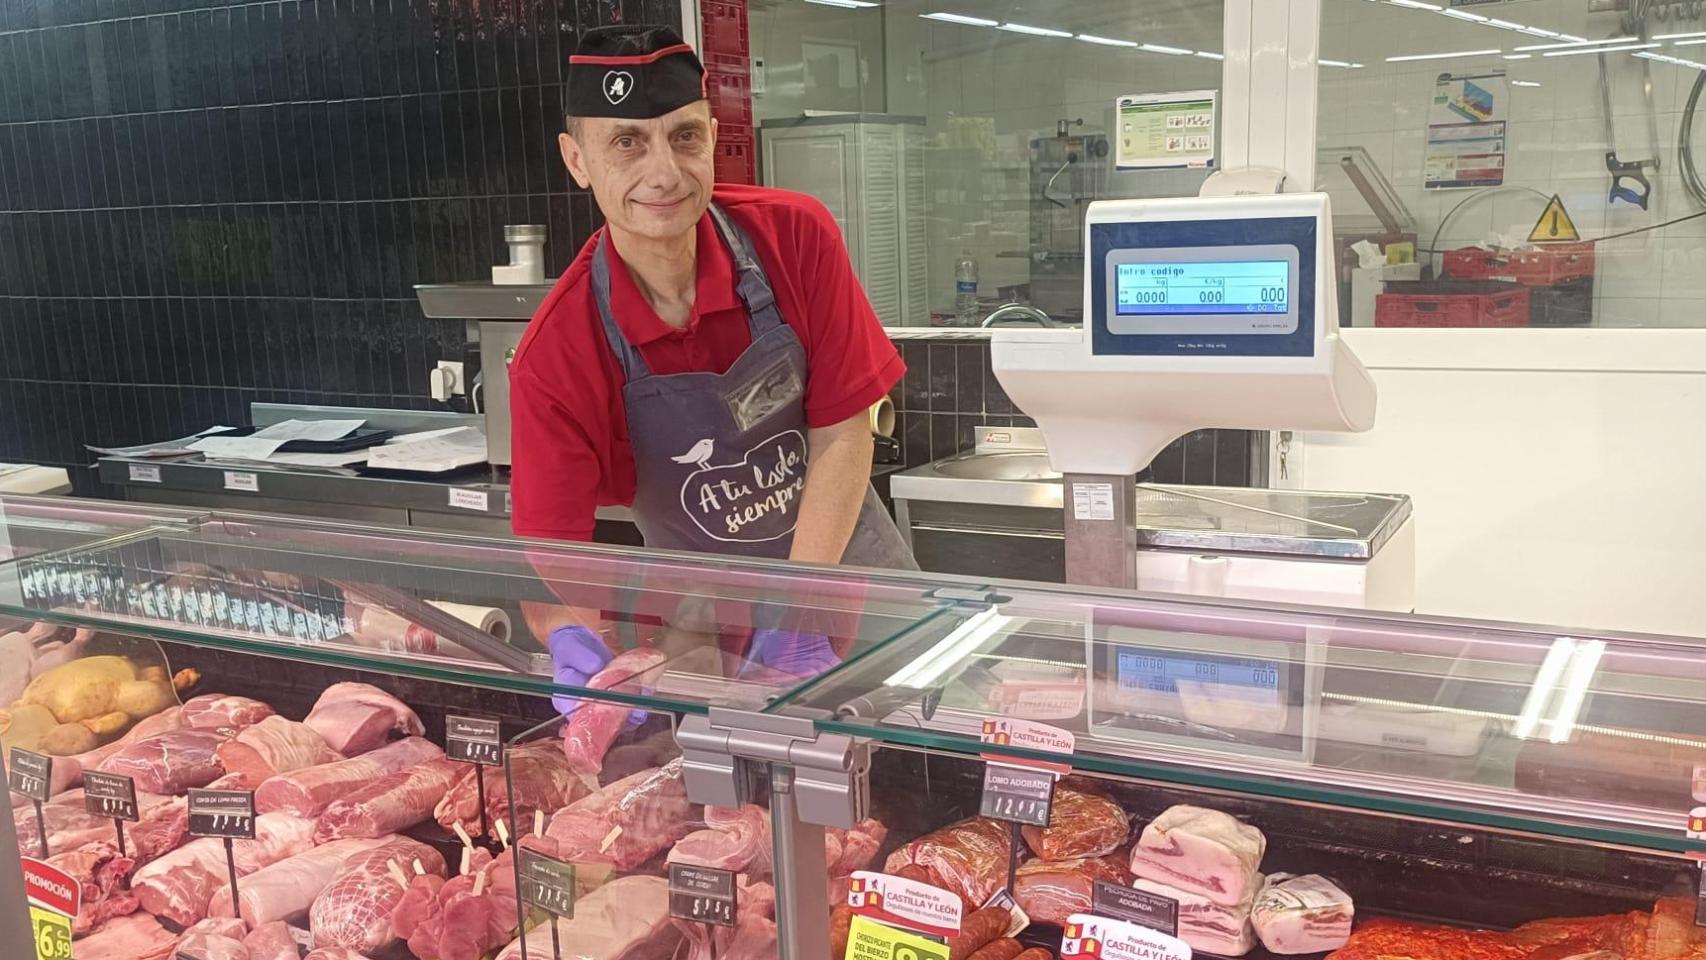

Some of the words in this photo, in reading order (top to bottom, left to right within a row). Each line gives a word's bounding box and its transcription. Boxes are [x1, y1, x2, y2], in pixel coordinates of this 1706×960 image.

[1119, 267, 1146, 275] Intro
[699, 483, 721, 513] A
[711, 479, 753, 501] tu
[725, 476, 804, 533] siempre
[1013, 731, 1044, 744] CASTILLA
[1053, 738, 1072, 750] LEÓN
[988, 775, 1008, 785] LOMO
[1010, 778, 1050, 790] ADOBADO
[25, 871, 73, 901] PROMOCIÓN
[905, 887, 932, 901] Producto
[932, 895, 941, 903] de
[887, 891, 926, 910] CASTILLA
[927, 902, 935, 911] Y
[935, 903, 958, 917] LEÓN
[854, 942, 866, 953] DEL
[867, 946, 889, 959] BIERZO
[1106, 939, 1149, 958] CASTILLA
[1151, 950, 1159, 960] Y
[1127, 935, 1157, 950] Producto
[1157, 943, 1167, 952] de
